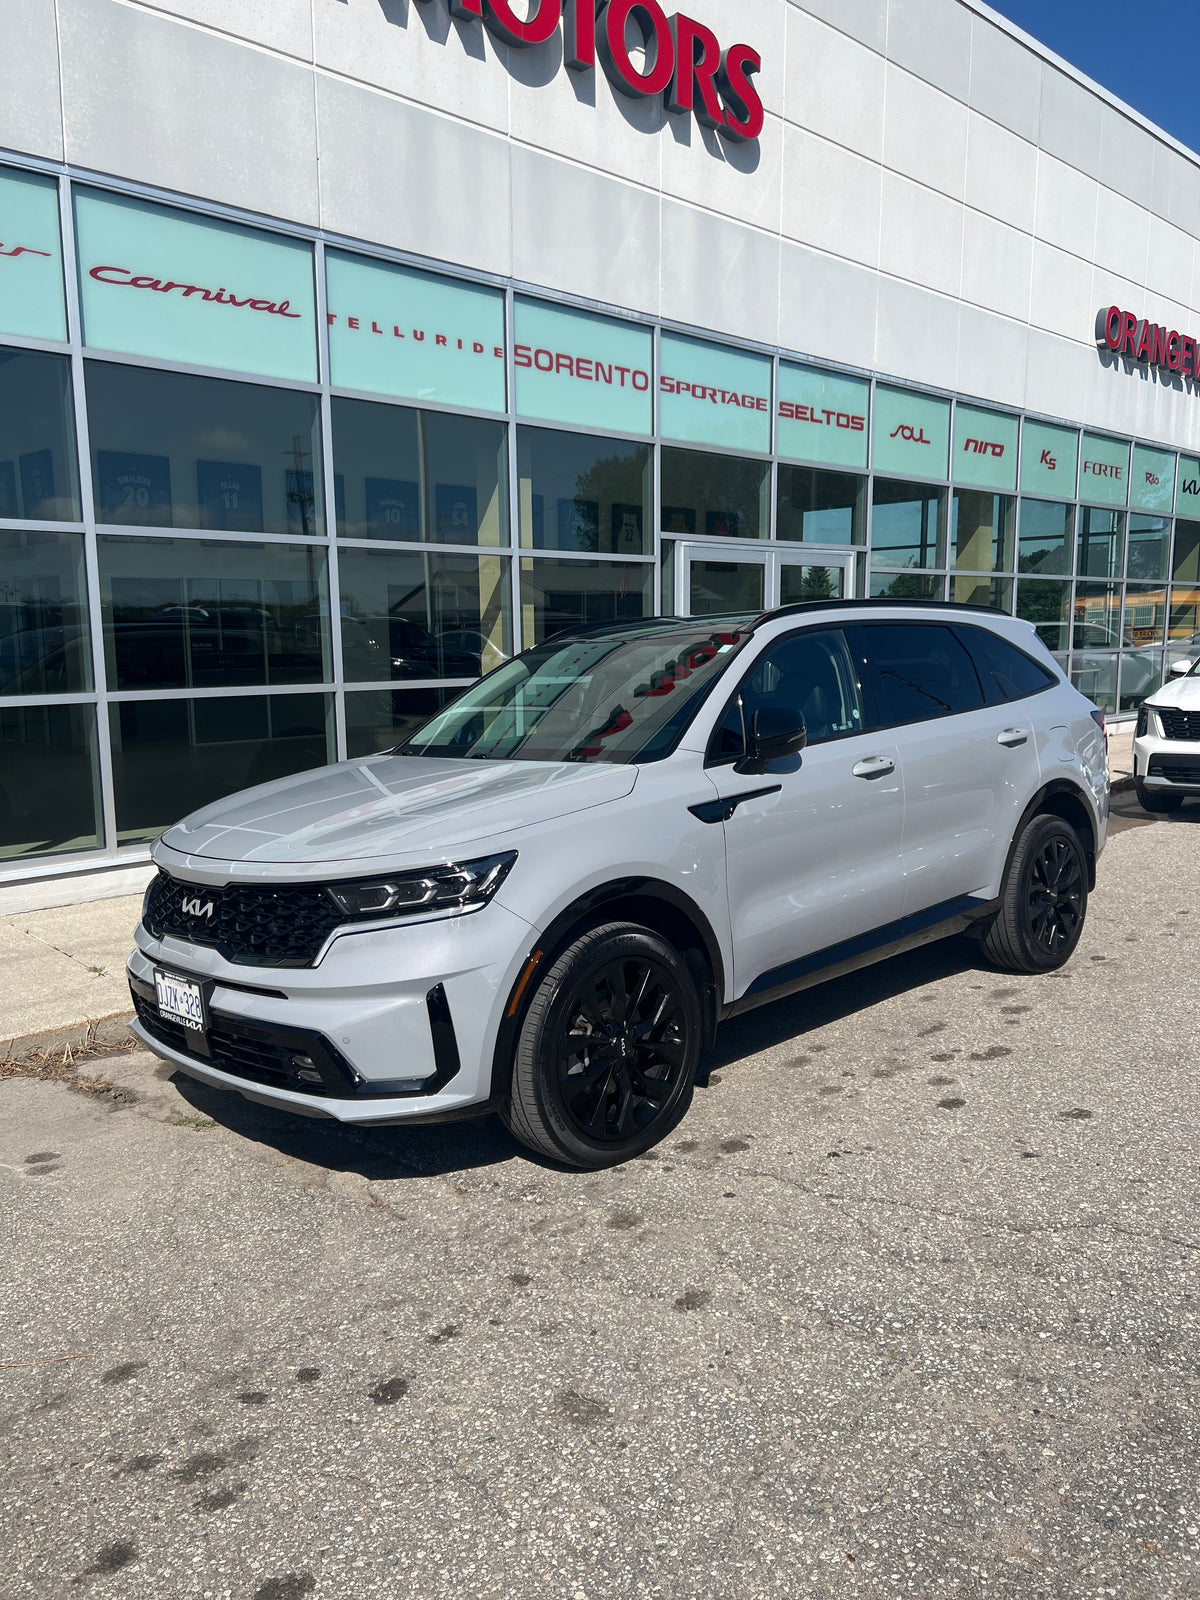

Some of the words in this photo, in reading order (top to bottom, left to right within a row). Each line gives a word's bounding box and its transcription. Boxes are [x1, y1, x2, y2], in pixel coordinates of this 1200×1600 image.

[448, 0, 764, 142] TORS
[89, 266, 302, 318] Carnival
[326, 313, 504, 358] TELLURIDE
[513, 344, 649, 391] SORENTO
[660, 375, 768, 412] SPORTAGE
[778, 401, 866, 431] SELTOS
[1040, 449, 1057, 470] K5
[1083, 460, 1123, 480] FORTE
[1145, 472, 1160, 485] Rio
[123, 486, 150, 506] 20
[181, 897, 214, 918] KIA
